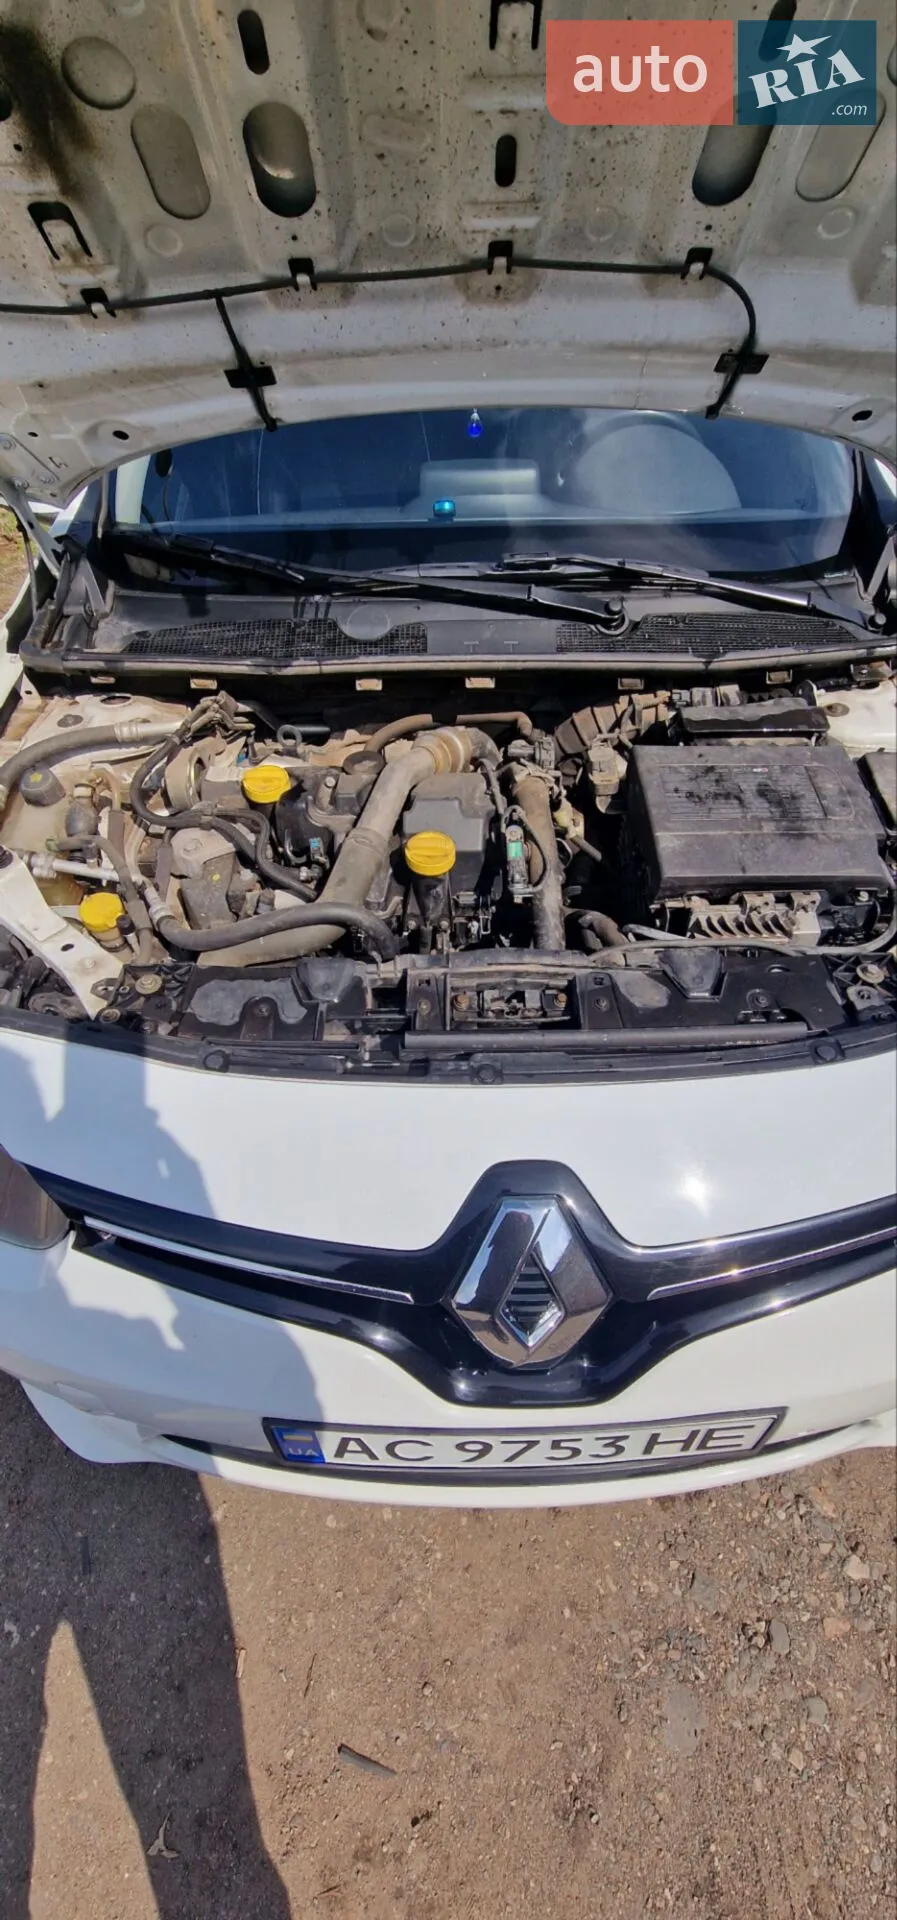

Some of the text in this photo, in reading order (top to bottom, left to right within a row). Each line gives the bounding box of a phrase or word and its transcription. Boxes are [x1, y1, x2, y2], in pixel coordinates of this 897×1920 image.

[288, 1447, 320, 1457] UA
[333, 1424, 756, 1463] AC 9753 HE
